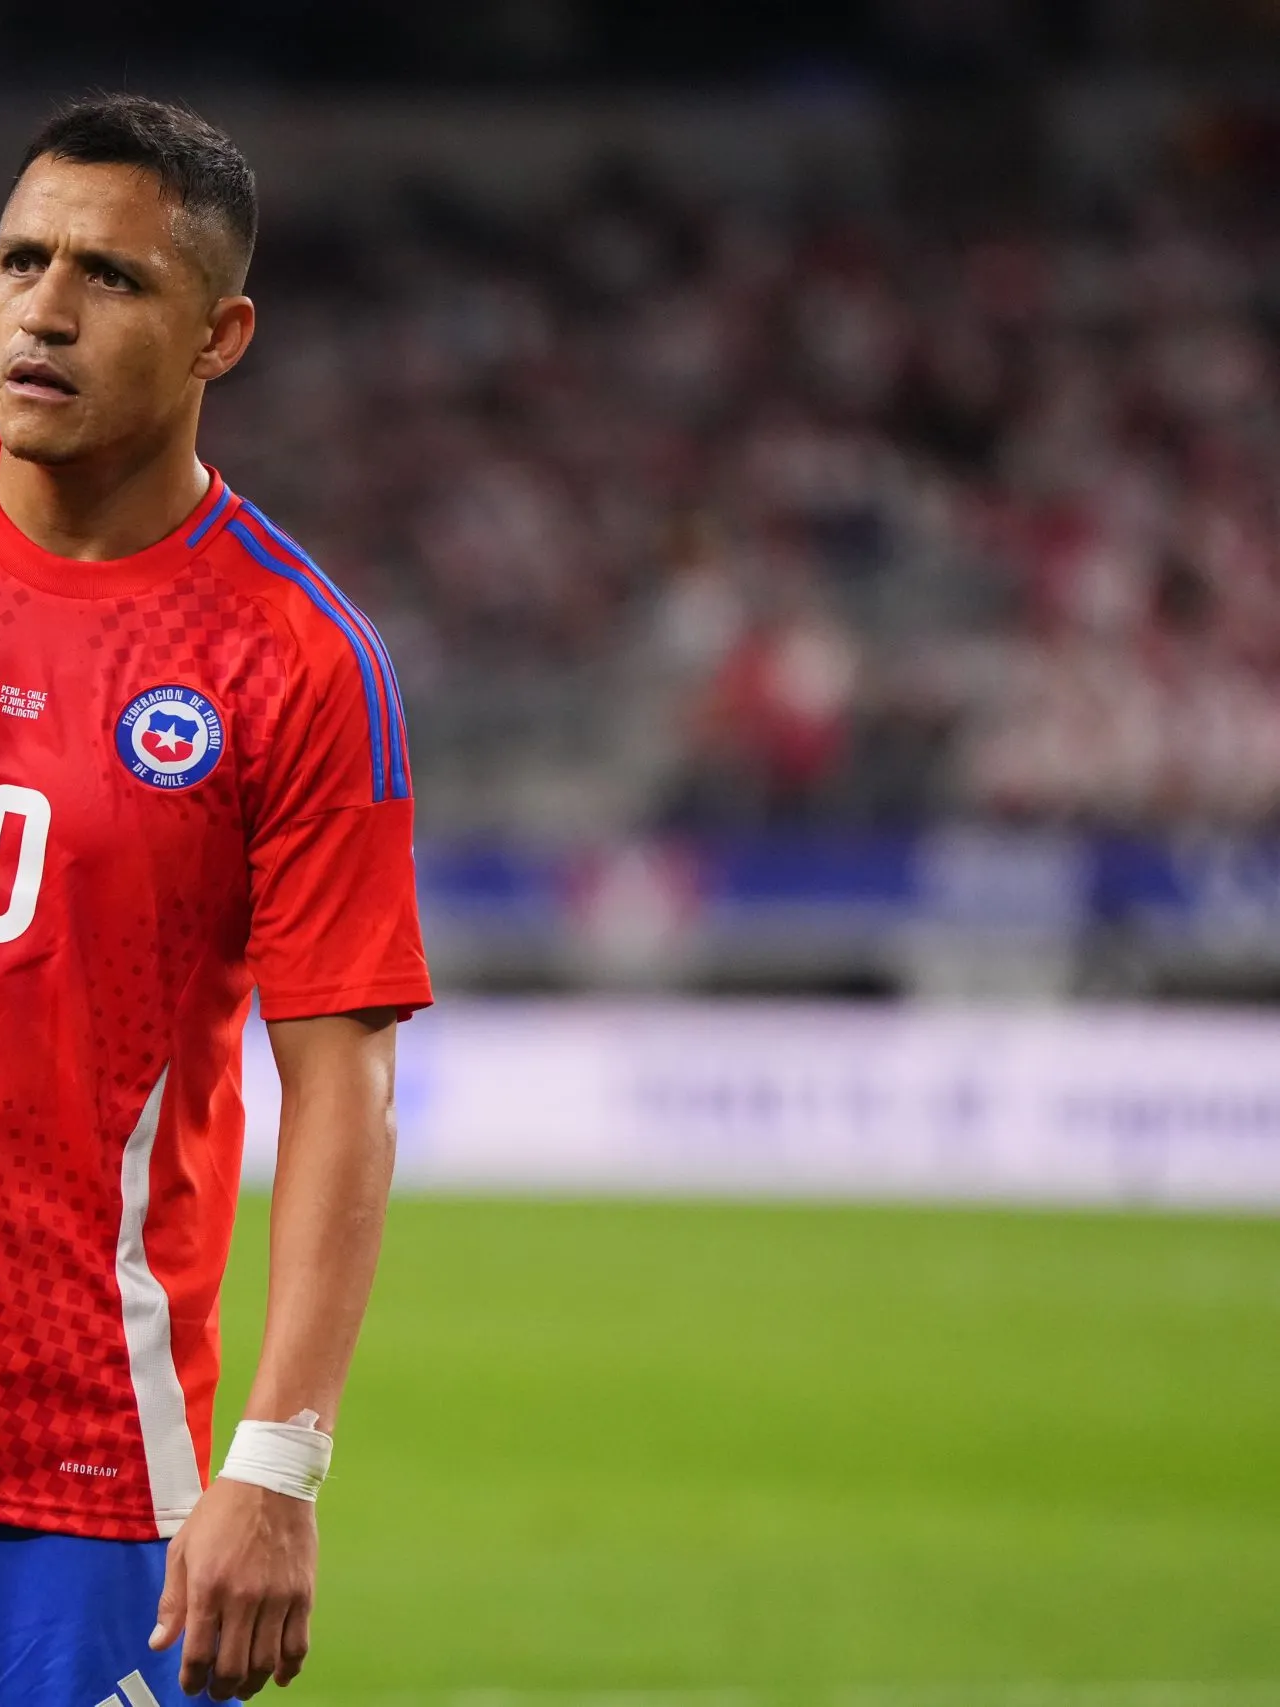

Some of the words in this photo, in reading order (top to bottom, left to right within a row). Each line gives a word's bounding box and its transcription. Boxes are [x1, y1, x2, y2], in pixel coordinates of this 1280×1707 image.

[1, 685, 20, 696] PERU
[27, 690, 48, 701] CHILE
[0, 695, 7, 703] 21
[8, 697, 26, 708] JUNE
[27, 701, 44, 711] 2024
[2, 705, 38, 719] ARLINGTON
[122, 689, 183, 727] FEDERACION
[189, 694, 205, 710] DE
[203, 710, 221, 751] FUTBOL
[133, 764, 149, 777] DE
[153, 774, 185, 786] CHILE
[60, 1462, 118, 1477] AEROREADY
